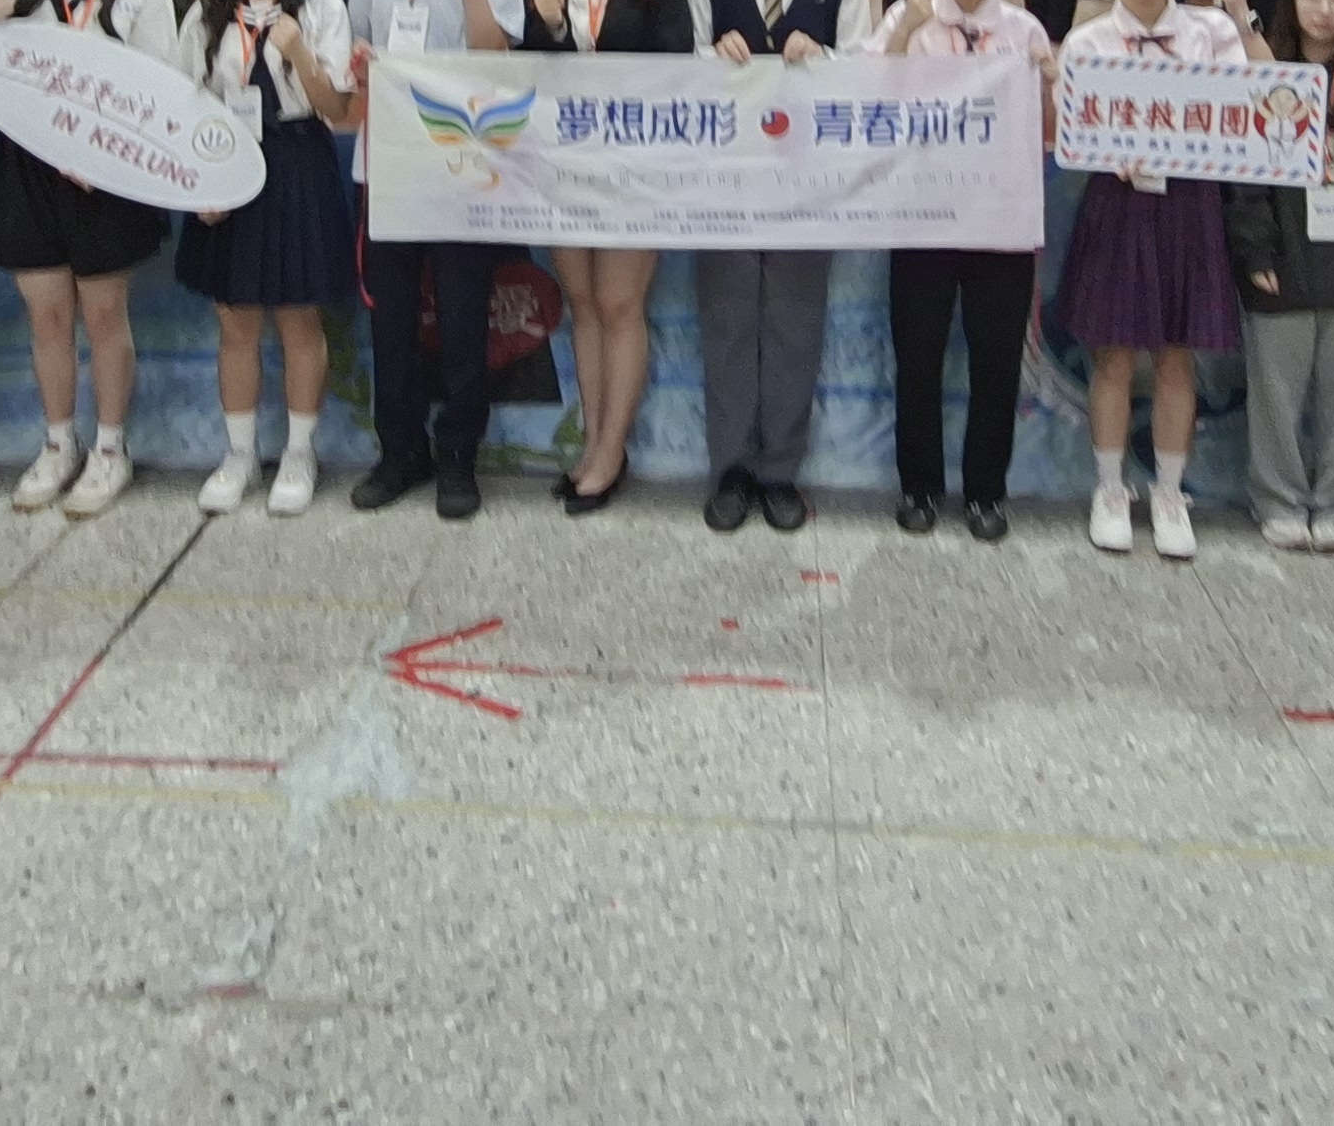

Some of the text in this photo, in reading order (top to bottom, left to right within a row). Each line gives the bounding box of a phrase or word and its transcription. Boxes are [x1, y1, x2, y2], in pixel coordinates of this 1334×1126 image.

[555, 94, 999, 149] 夢想成形 青春前行
[1078, 90, 1250, 139] 基隆救國團
[51, 105, 201, 192] IN KEELUNG
